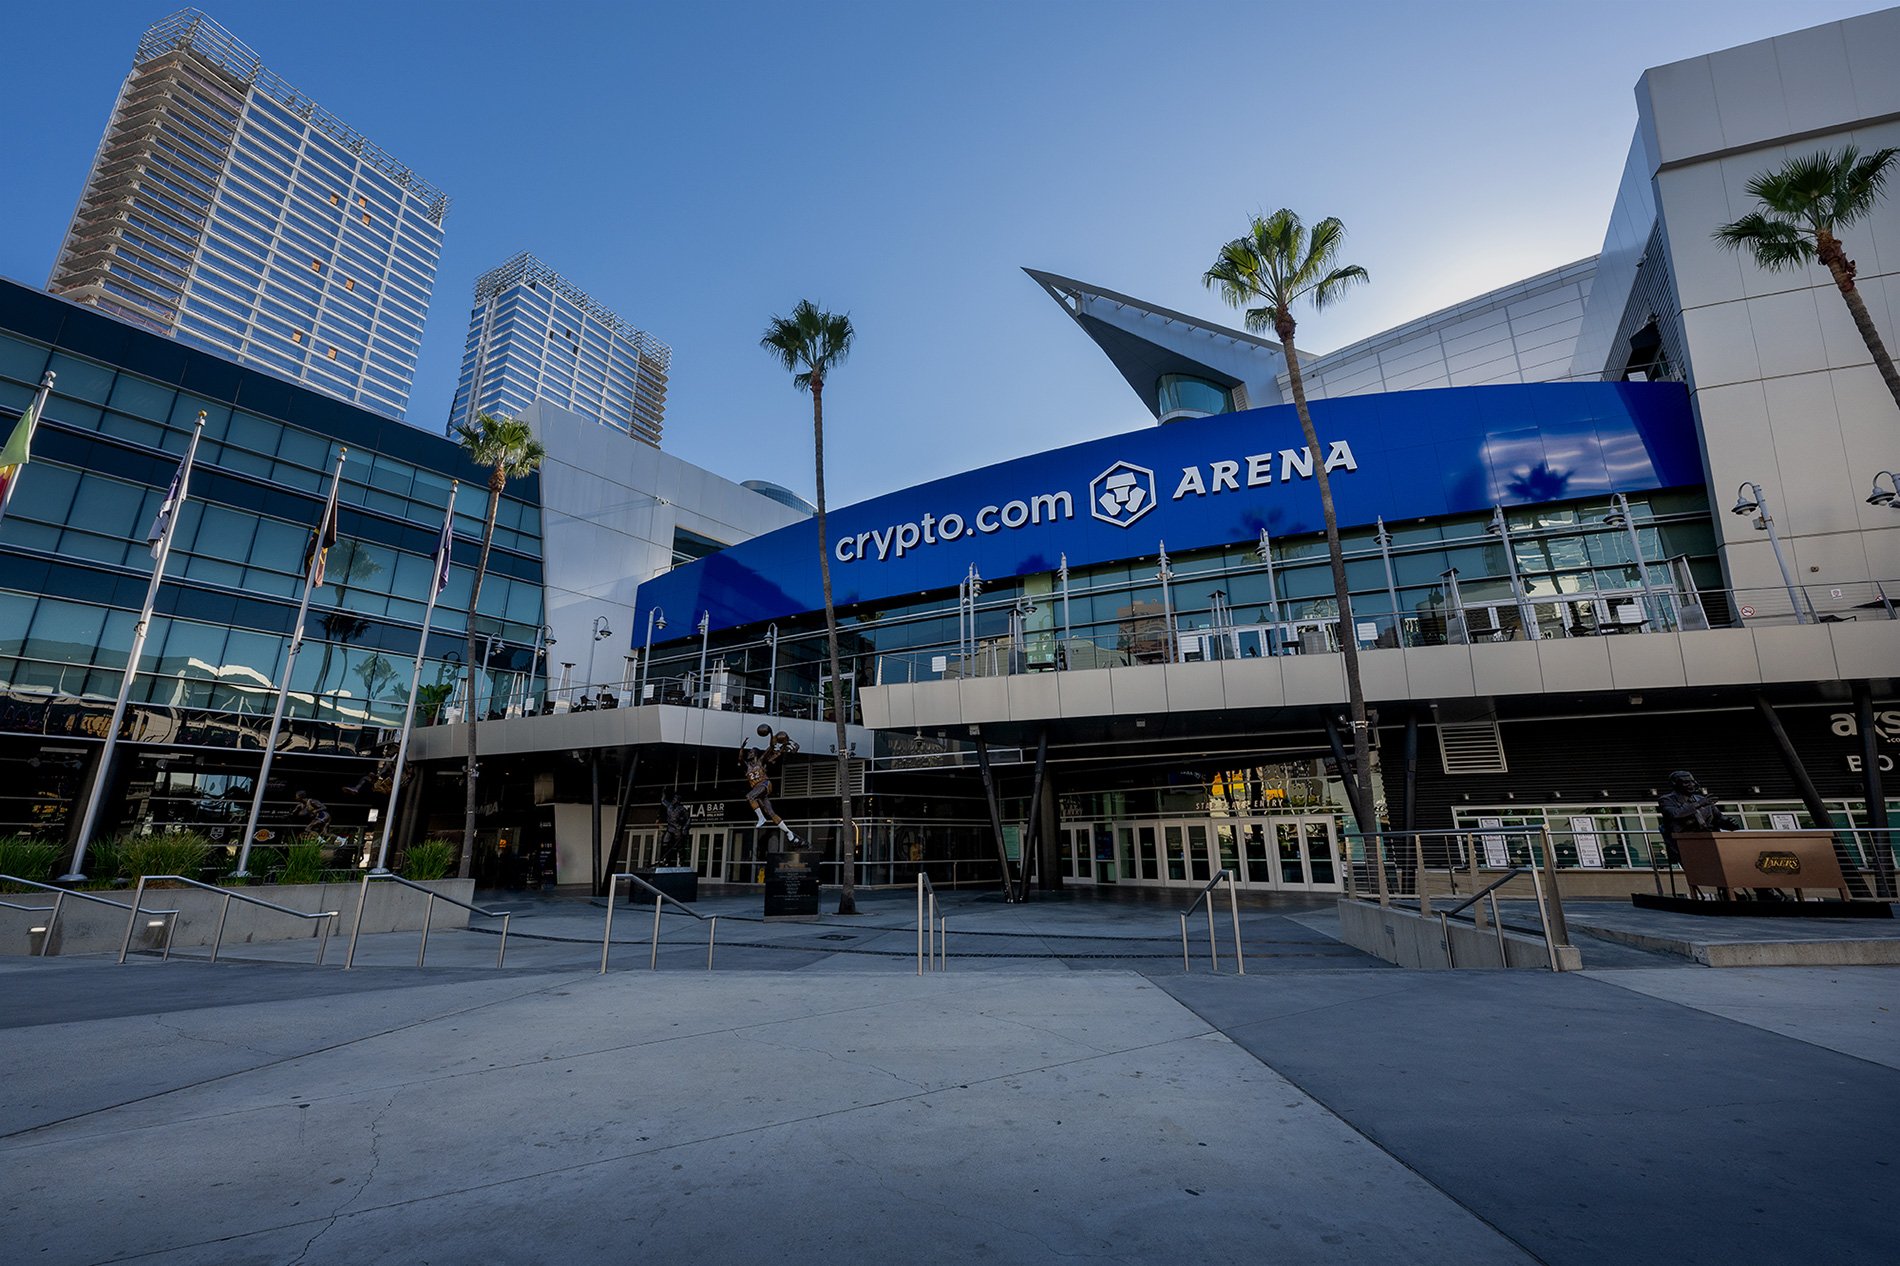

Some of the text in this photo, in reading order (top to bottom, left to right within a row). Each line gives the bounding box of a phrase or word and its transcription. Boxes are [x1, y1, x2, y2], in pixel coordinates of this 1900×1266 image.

[835, 440, 1358, 562] crypto.com ARENA
[706, 802, 725, 811] BAR
[1253, 799, 1284, 808] ENTRY
[1763, 856, 1800, 870] LAKERS
